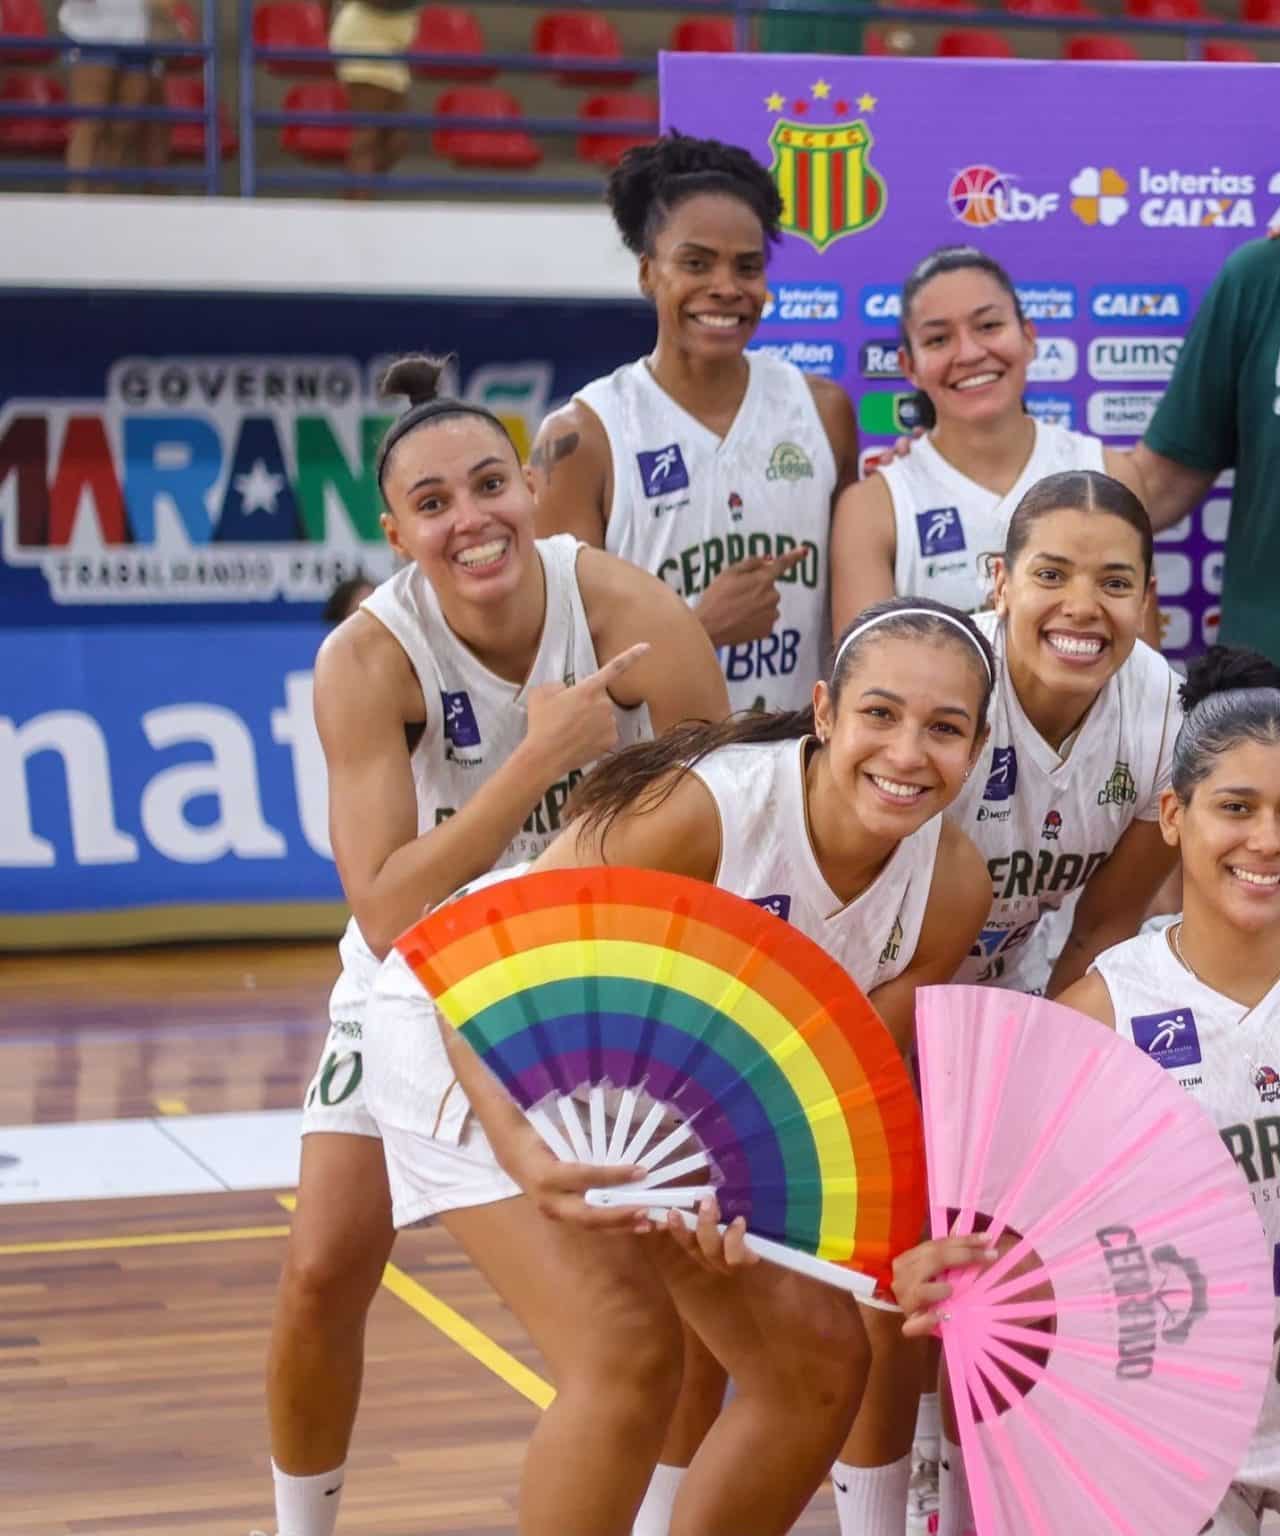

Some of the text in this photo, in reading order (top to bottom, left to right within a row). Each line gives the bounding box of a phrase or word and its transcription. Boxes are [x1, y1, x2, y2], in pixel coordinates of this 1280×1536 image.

[1140, 166, 1256, 194] loterias
[1140, 199, 1256, 227] CAIXA
[779, 303, 838, 319] CAIXA
[1093, 294, 1179, 316] CAIXA
[119, 368, 355, 402] GOVERNO
